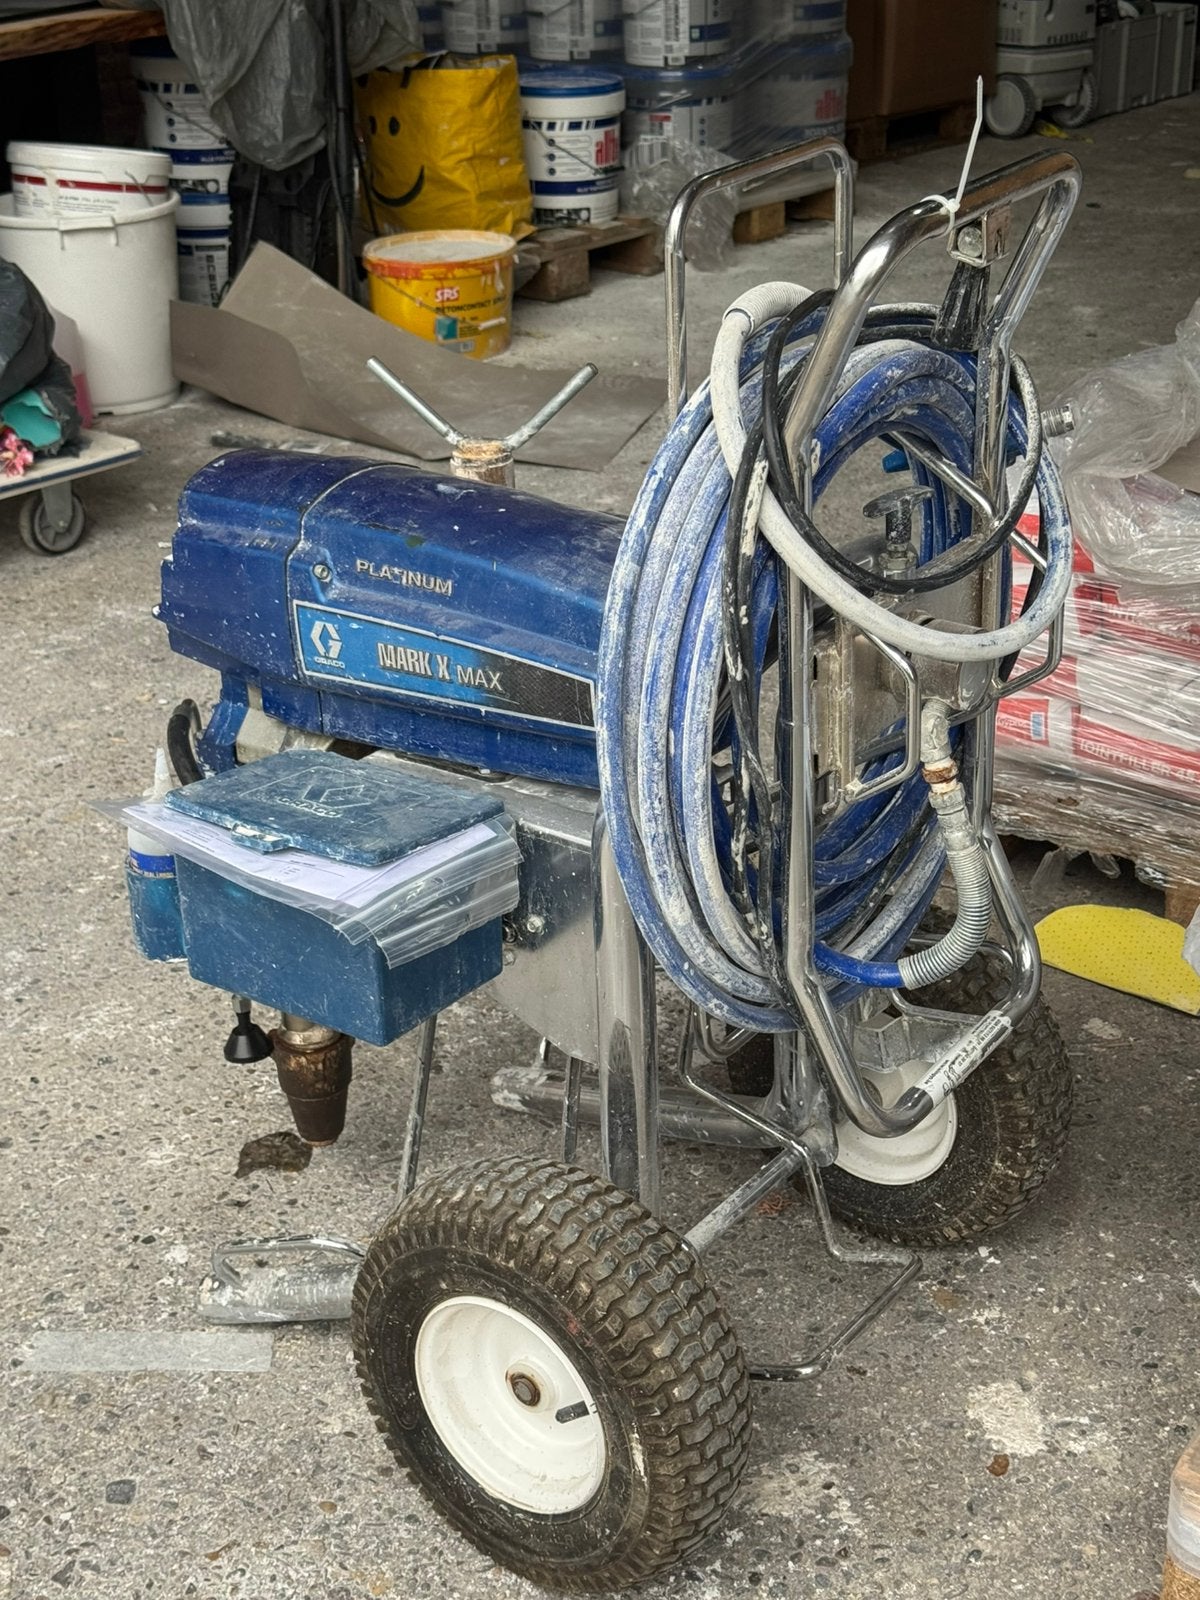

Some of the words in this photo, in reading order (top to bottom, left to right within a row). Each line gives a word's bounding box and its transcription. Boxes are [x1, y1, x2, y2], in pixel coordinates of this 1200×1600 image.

[435, 286, 460, 302] SPS
[314, 656, 345, 669] GRACO
[377, 642, 432, 677] MARK
[436, 654, 450, 681] X
[456, 664, 503, 692] MAX
